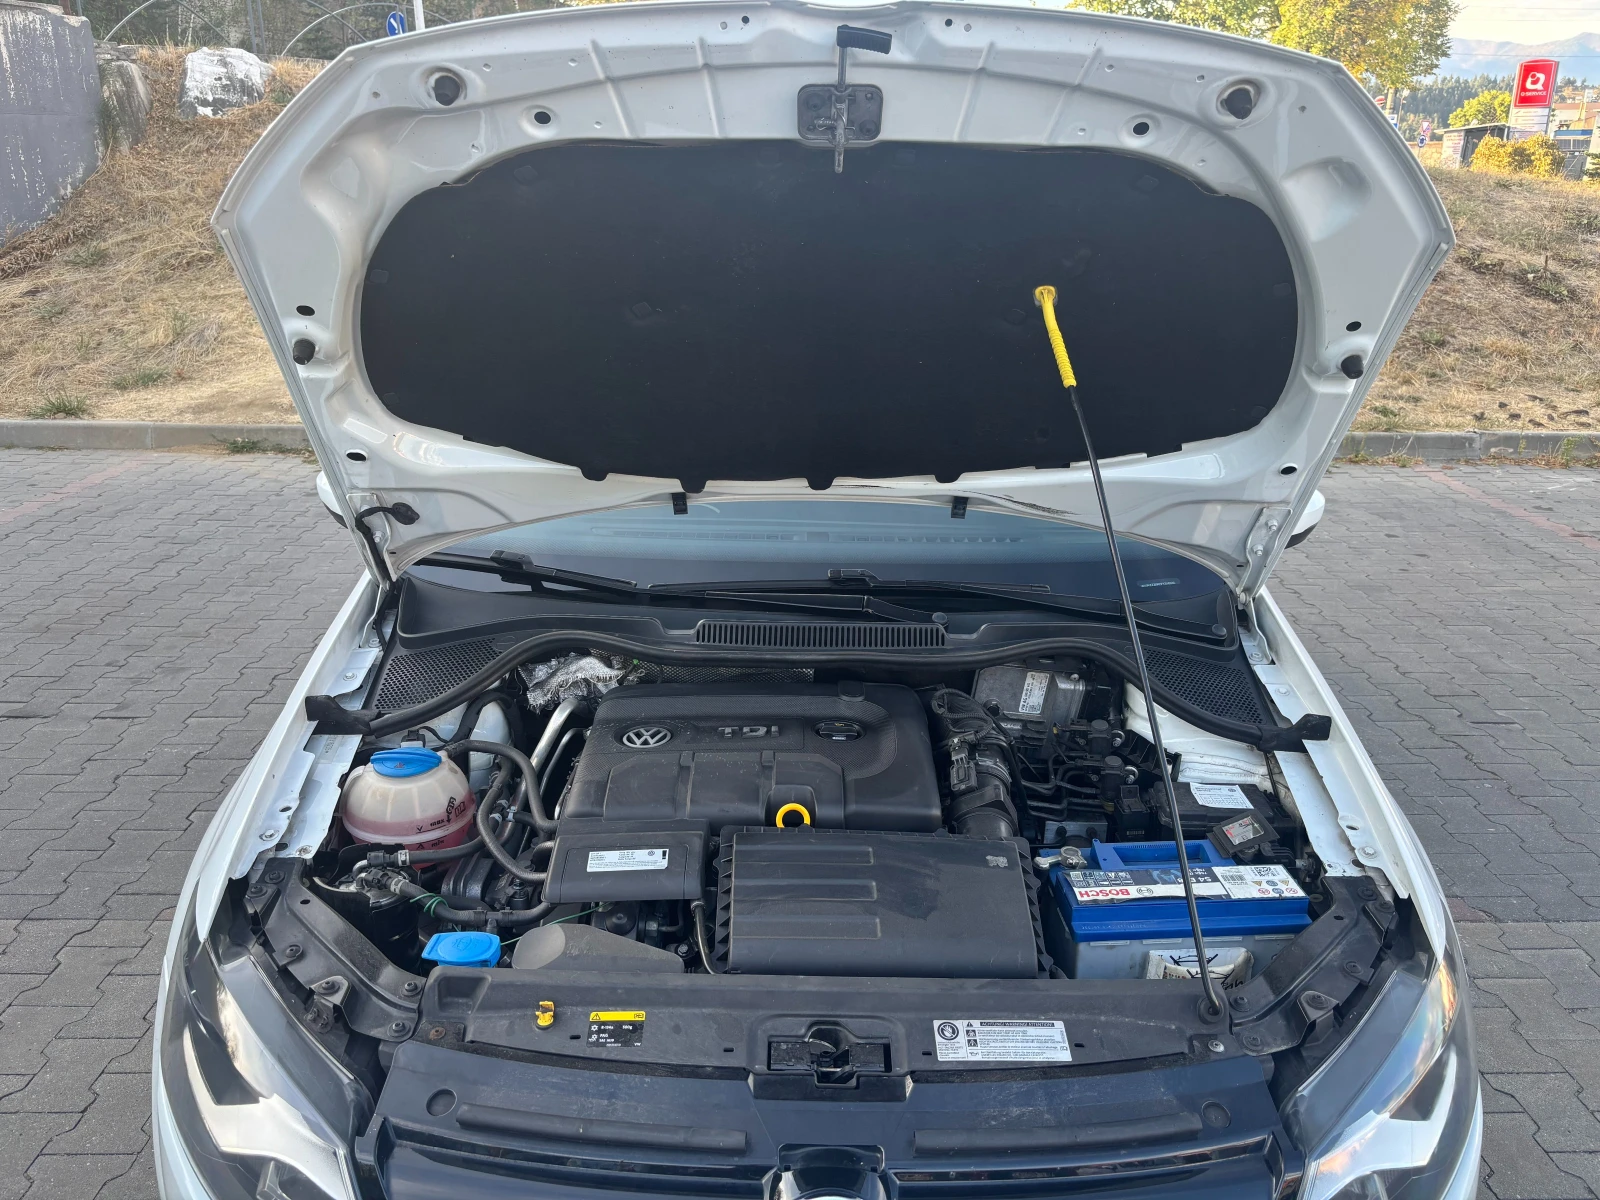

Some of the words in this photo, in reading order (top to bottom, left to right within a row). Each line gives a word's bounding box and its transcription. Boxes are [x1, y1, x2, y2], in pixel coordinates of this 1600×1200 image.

[717, 725, 780, 739] TDI
[430, 819, 445, 827] max
[431, 840, 445, 848] min
[1078, 888, 1131, 898] BOSCH
